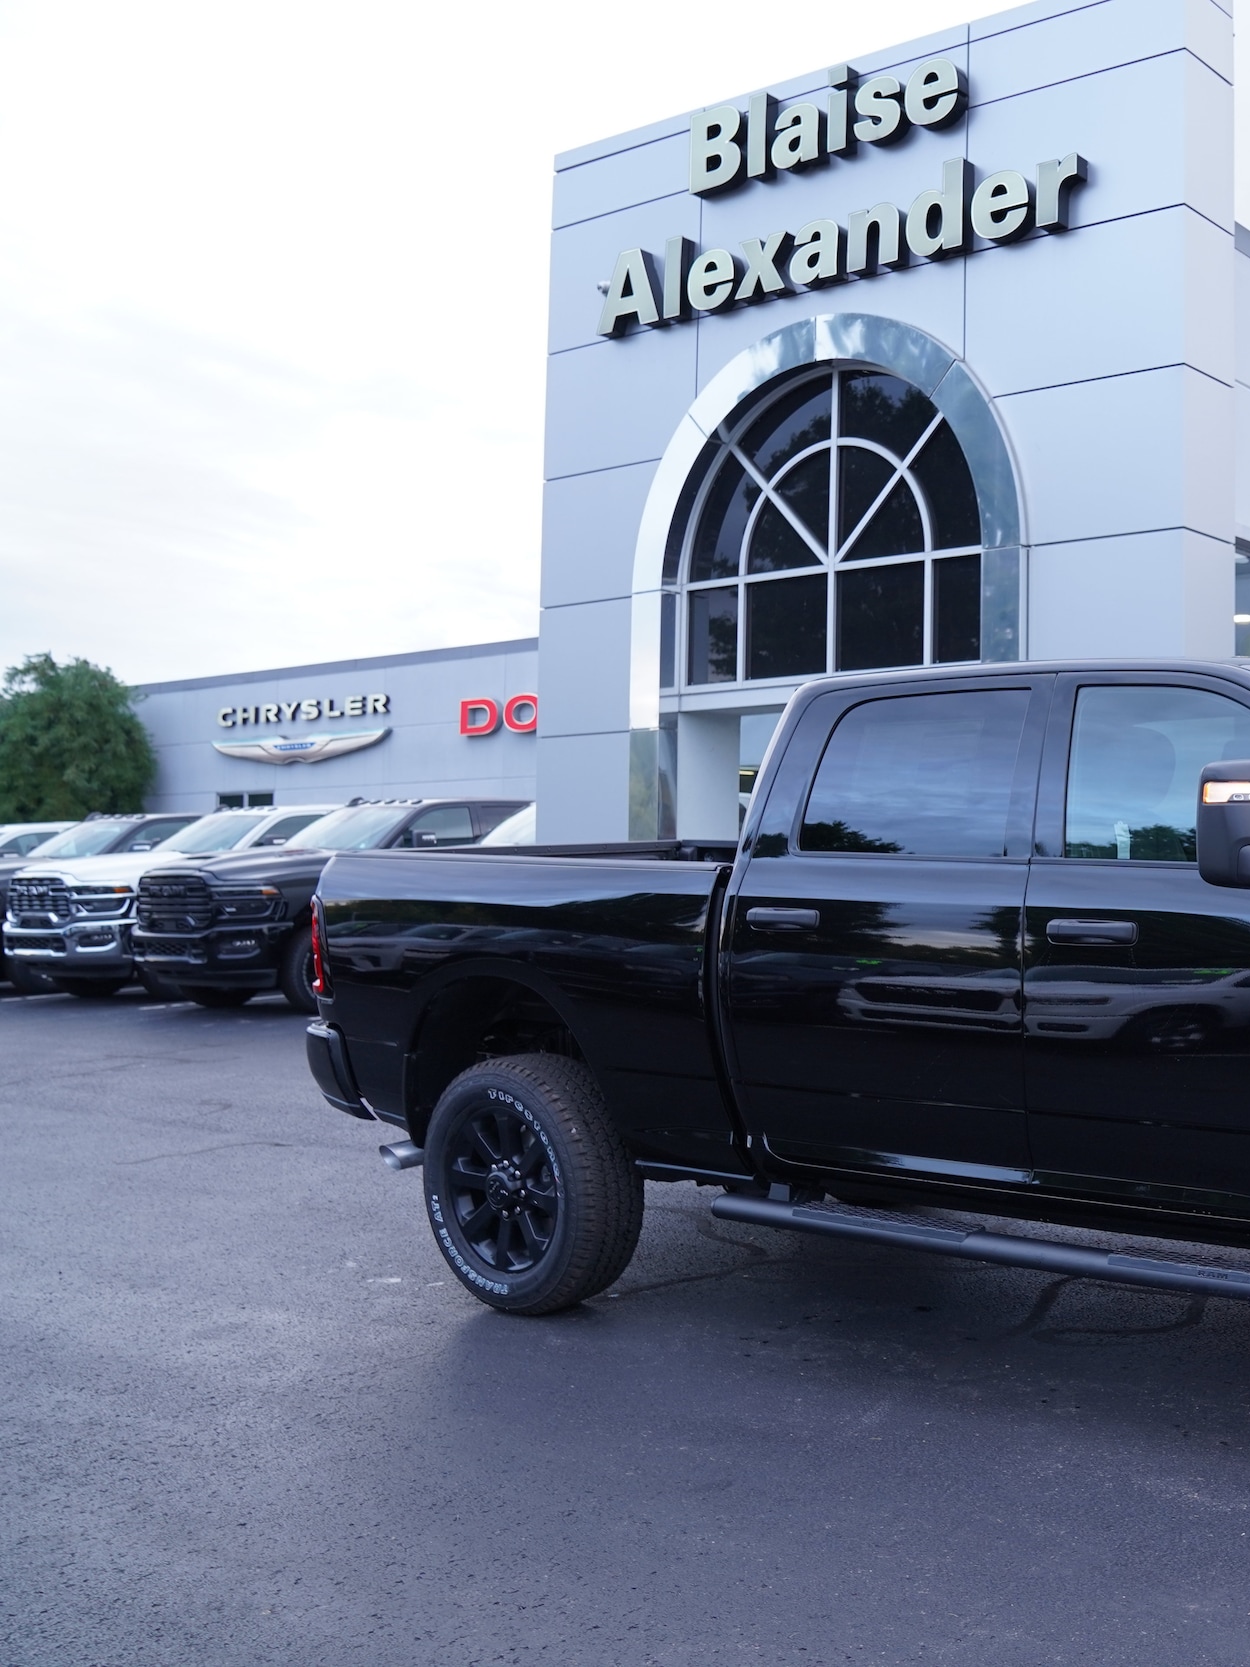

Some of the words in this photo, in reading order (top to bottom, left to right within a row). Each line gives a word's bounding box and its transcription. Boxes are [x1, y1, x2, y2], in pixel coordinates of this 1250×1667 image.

[690, 57, 966, 197] Blaise
[597, 152, 1087, 338] Alexander
[215, 693, 390, 728] CHRYSLER
[487, 1088, 562, 1179] Firestone
[439, 1228, 510, 1296] TRANSFORCE
